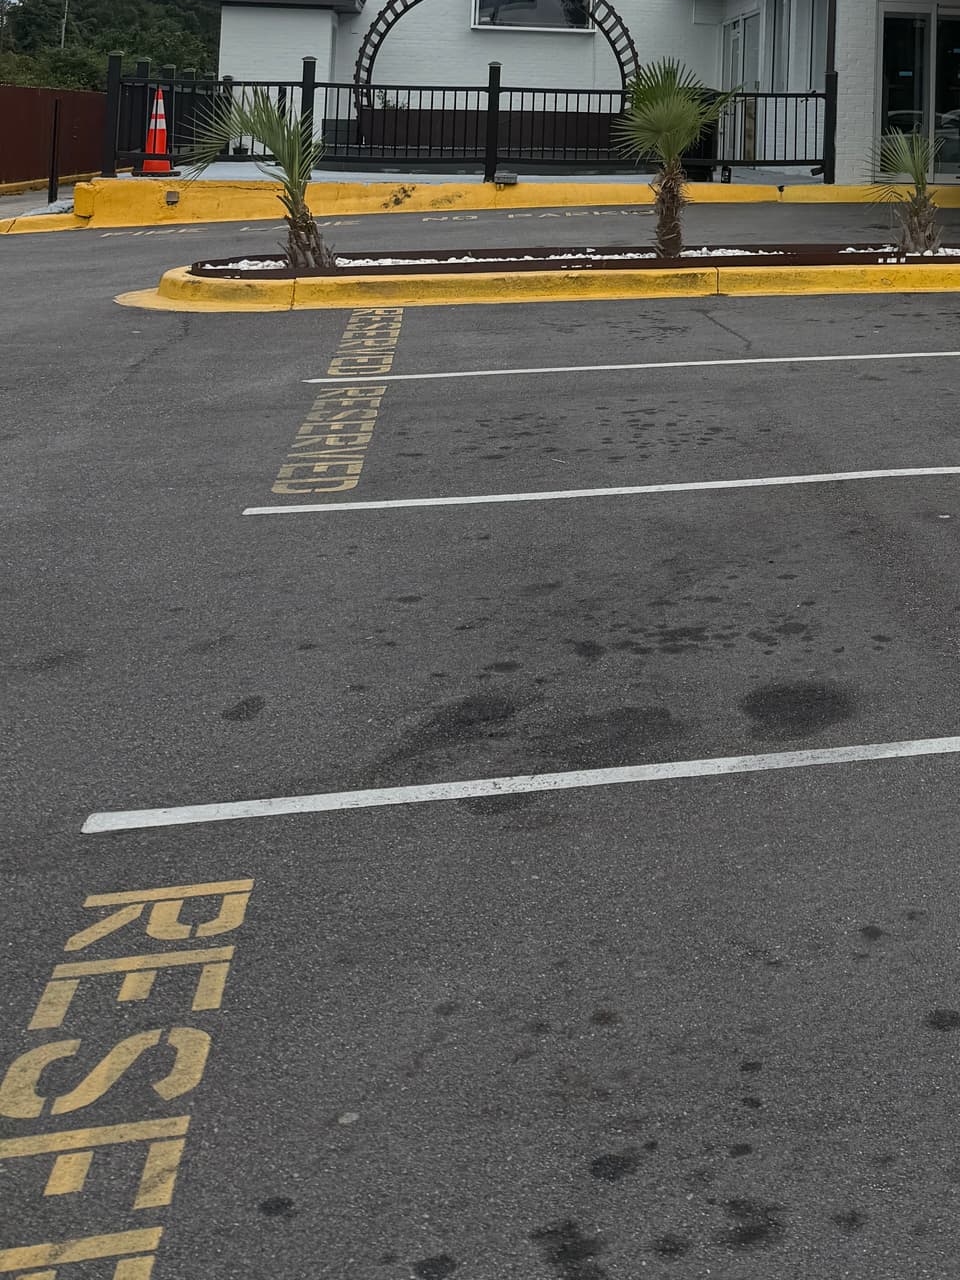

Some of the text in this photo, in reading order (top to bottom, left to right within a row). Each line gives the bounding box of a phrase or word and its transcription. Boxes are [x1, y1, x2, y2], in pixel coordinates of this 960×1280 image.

[421, 214, 478, 222] NO
[507, 209, 657, 219] PARKIN
[327, 307, 404, 376] RESERVED
[271, 385, 388, 494] RESERVED
